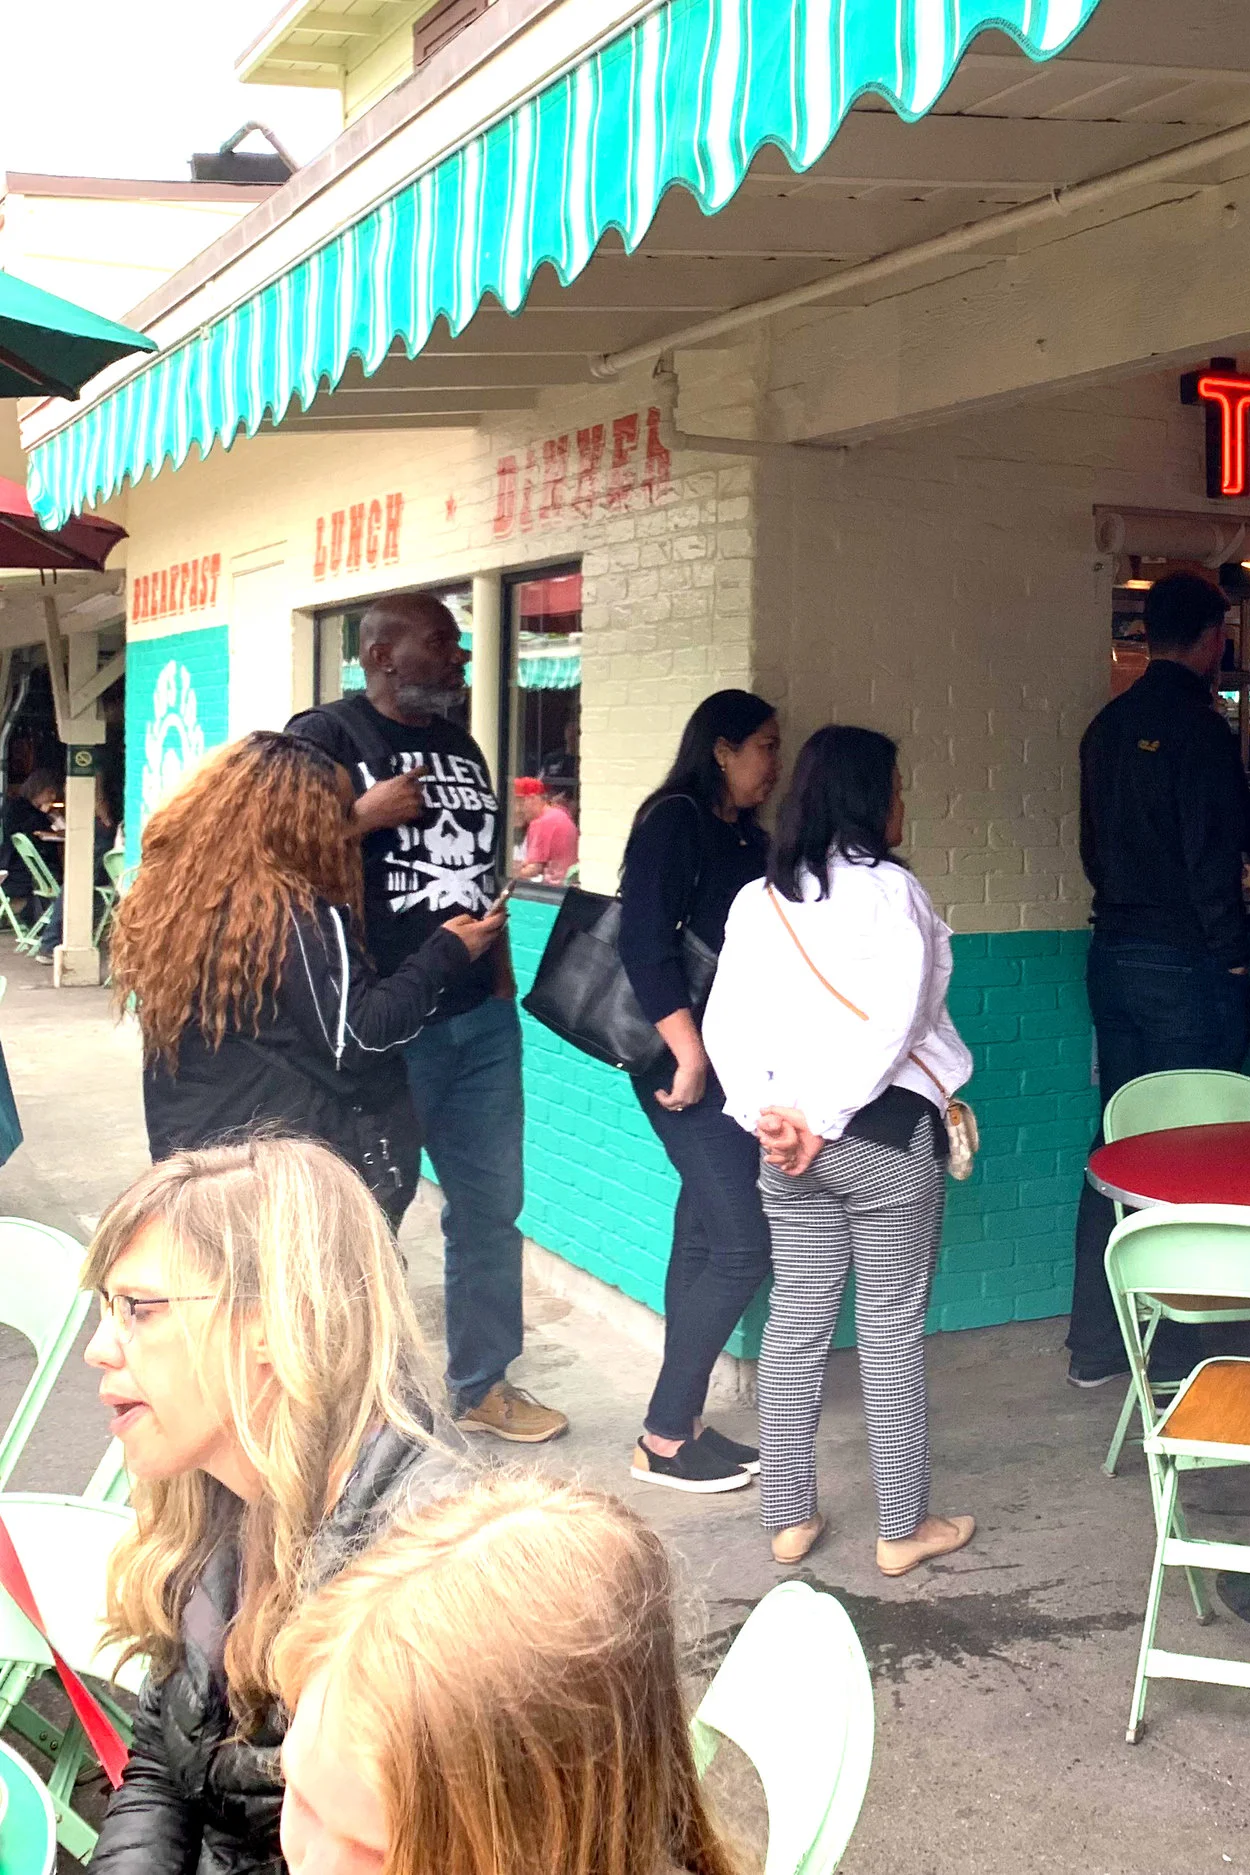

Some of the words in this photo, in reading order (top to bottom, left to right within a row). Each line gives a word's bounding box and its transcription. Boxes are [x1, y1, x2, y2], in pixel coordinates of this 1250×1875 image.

[131, 552, 221, 625] BREAKFAST
[313, 492, 405, 583] LUNCH
[421, 783, 483, 811] LUB
